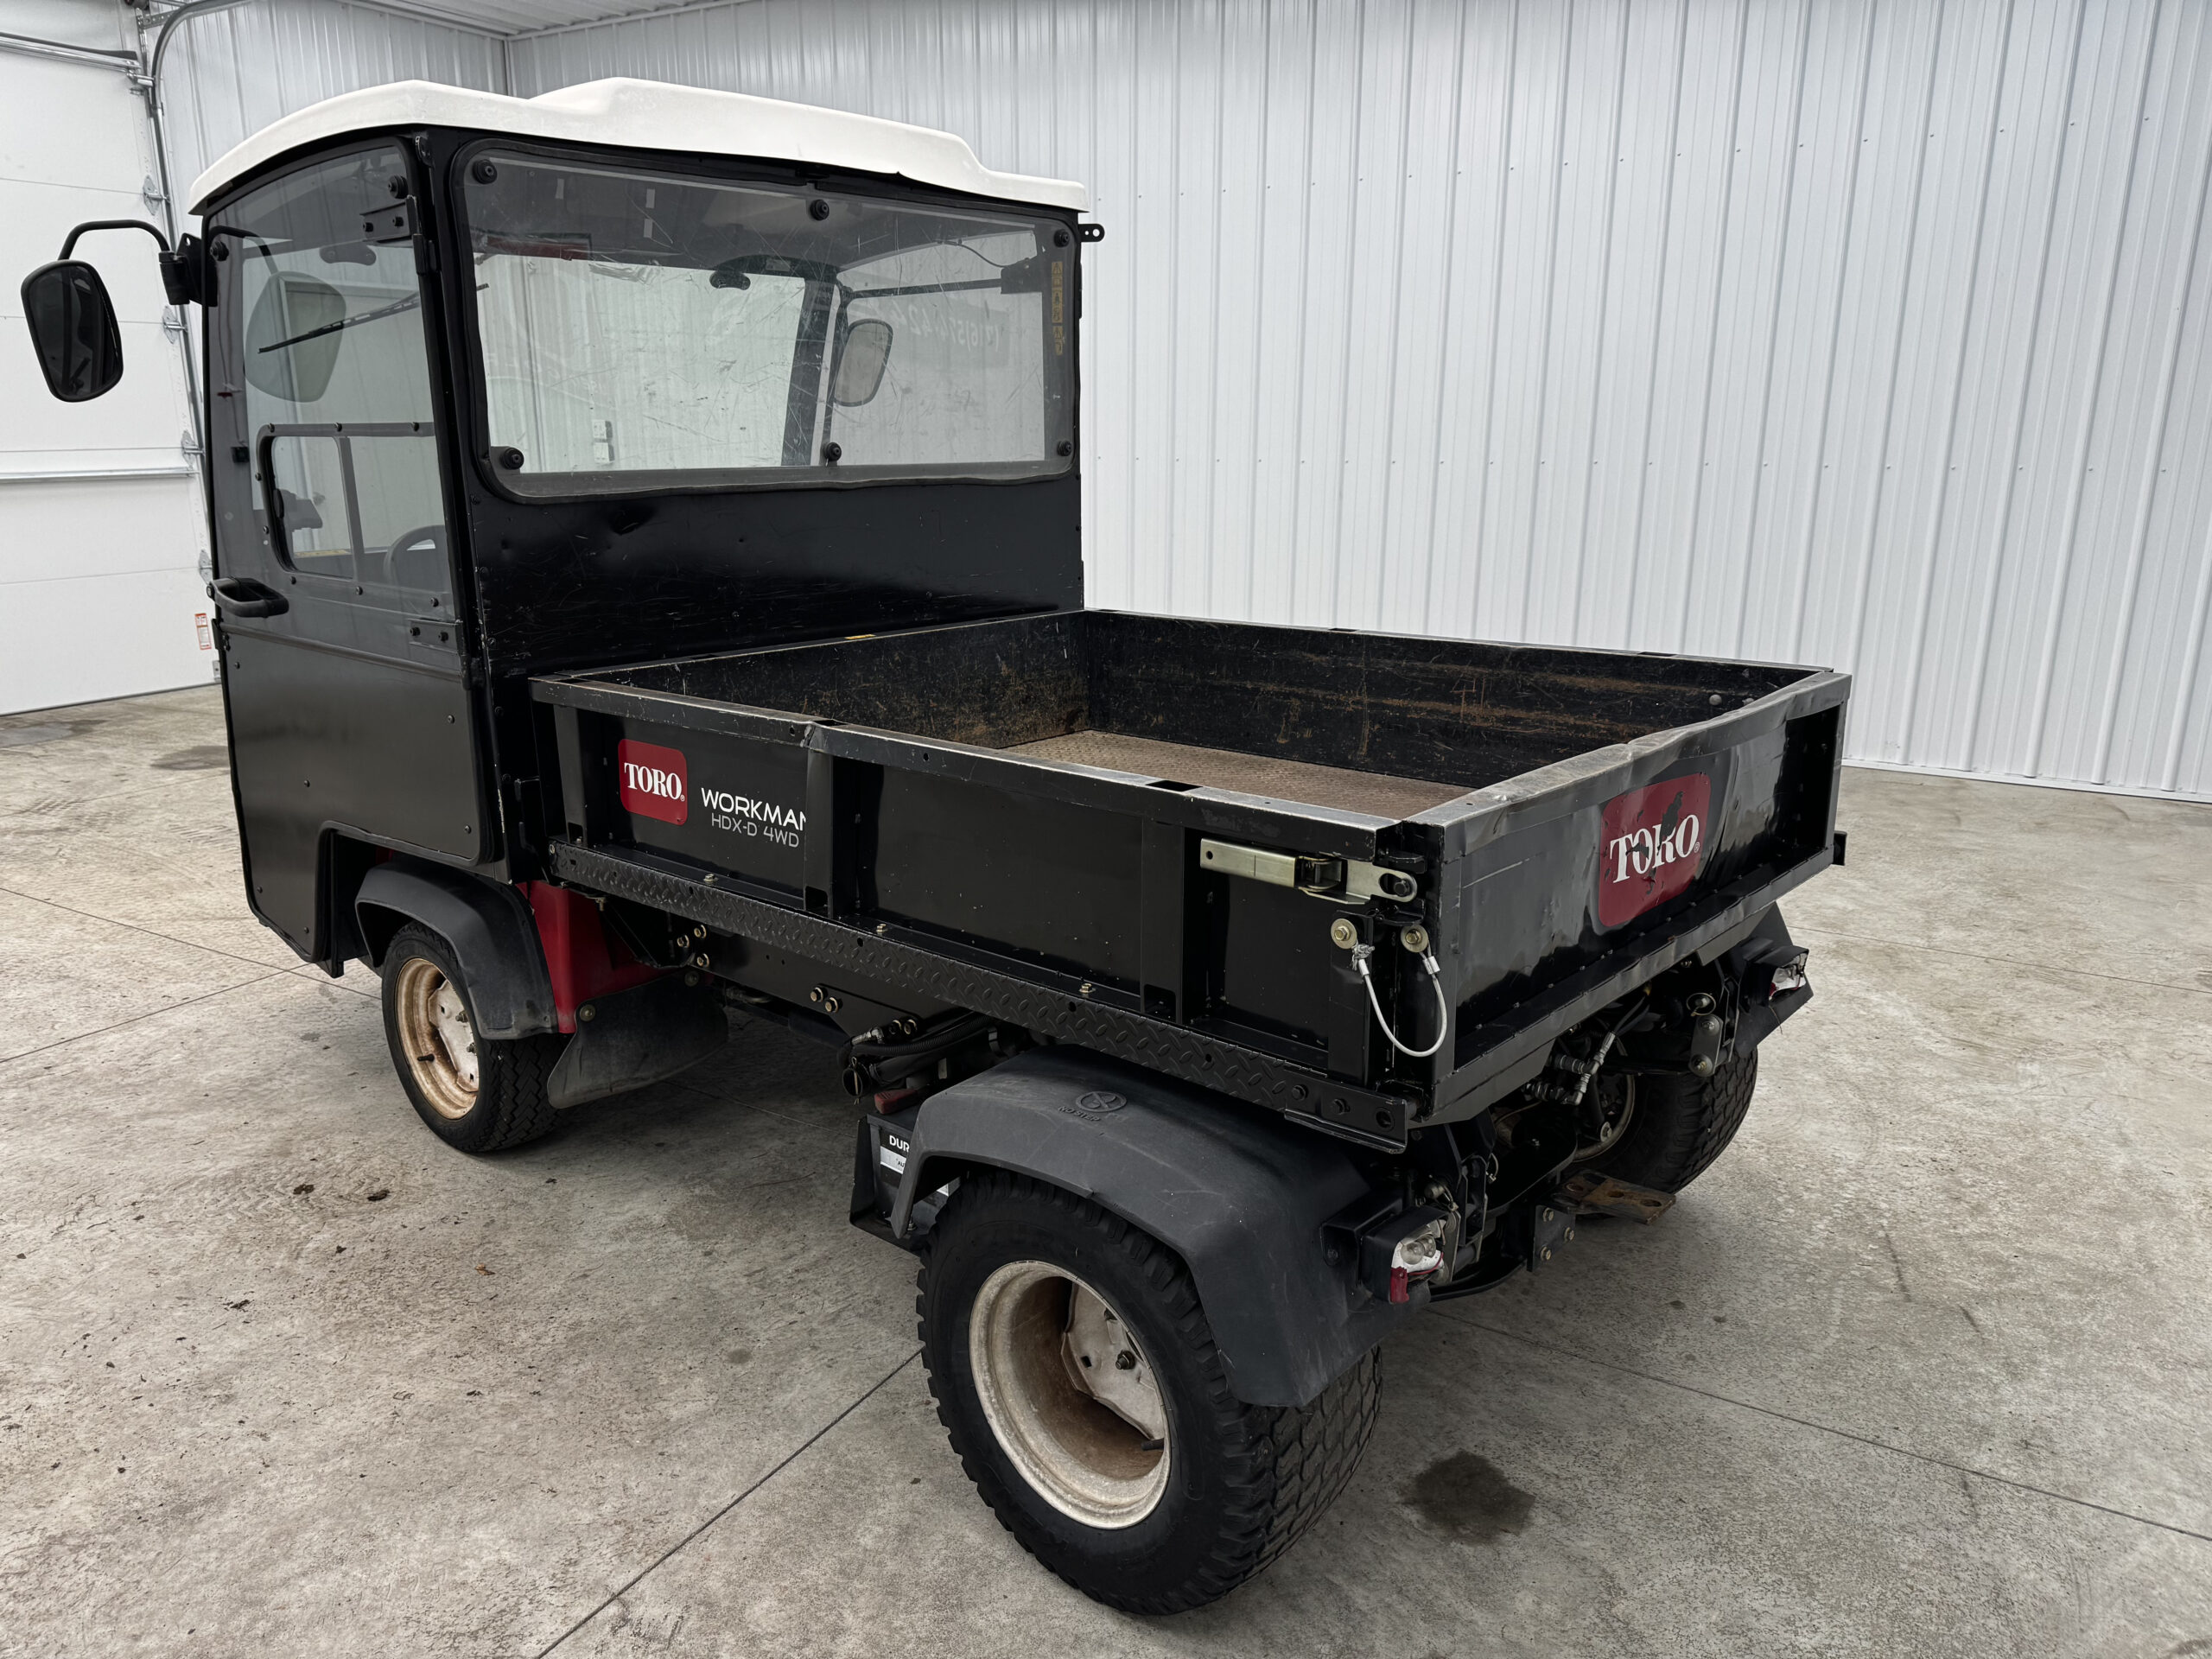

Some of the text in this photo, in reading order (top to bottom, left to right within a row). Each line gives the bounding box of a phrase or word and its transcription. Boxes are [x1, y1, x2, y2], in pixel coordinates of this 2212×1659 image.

[624, 762, 683, 800] TORO
[711, 812, 799, 848] HDX-D 4WD
[1074, 1110, 1101, 1122] STEP
